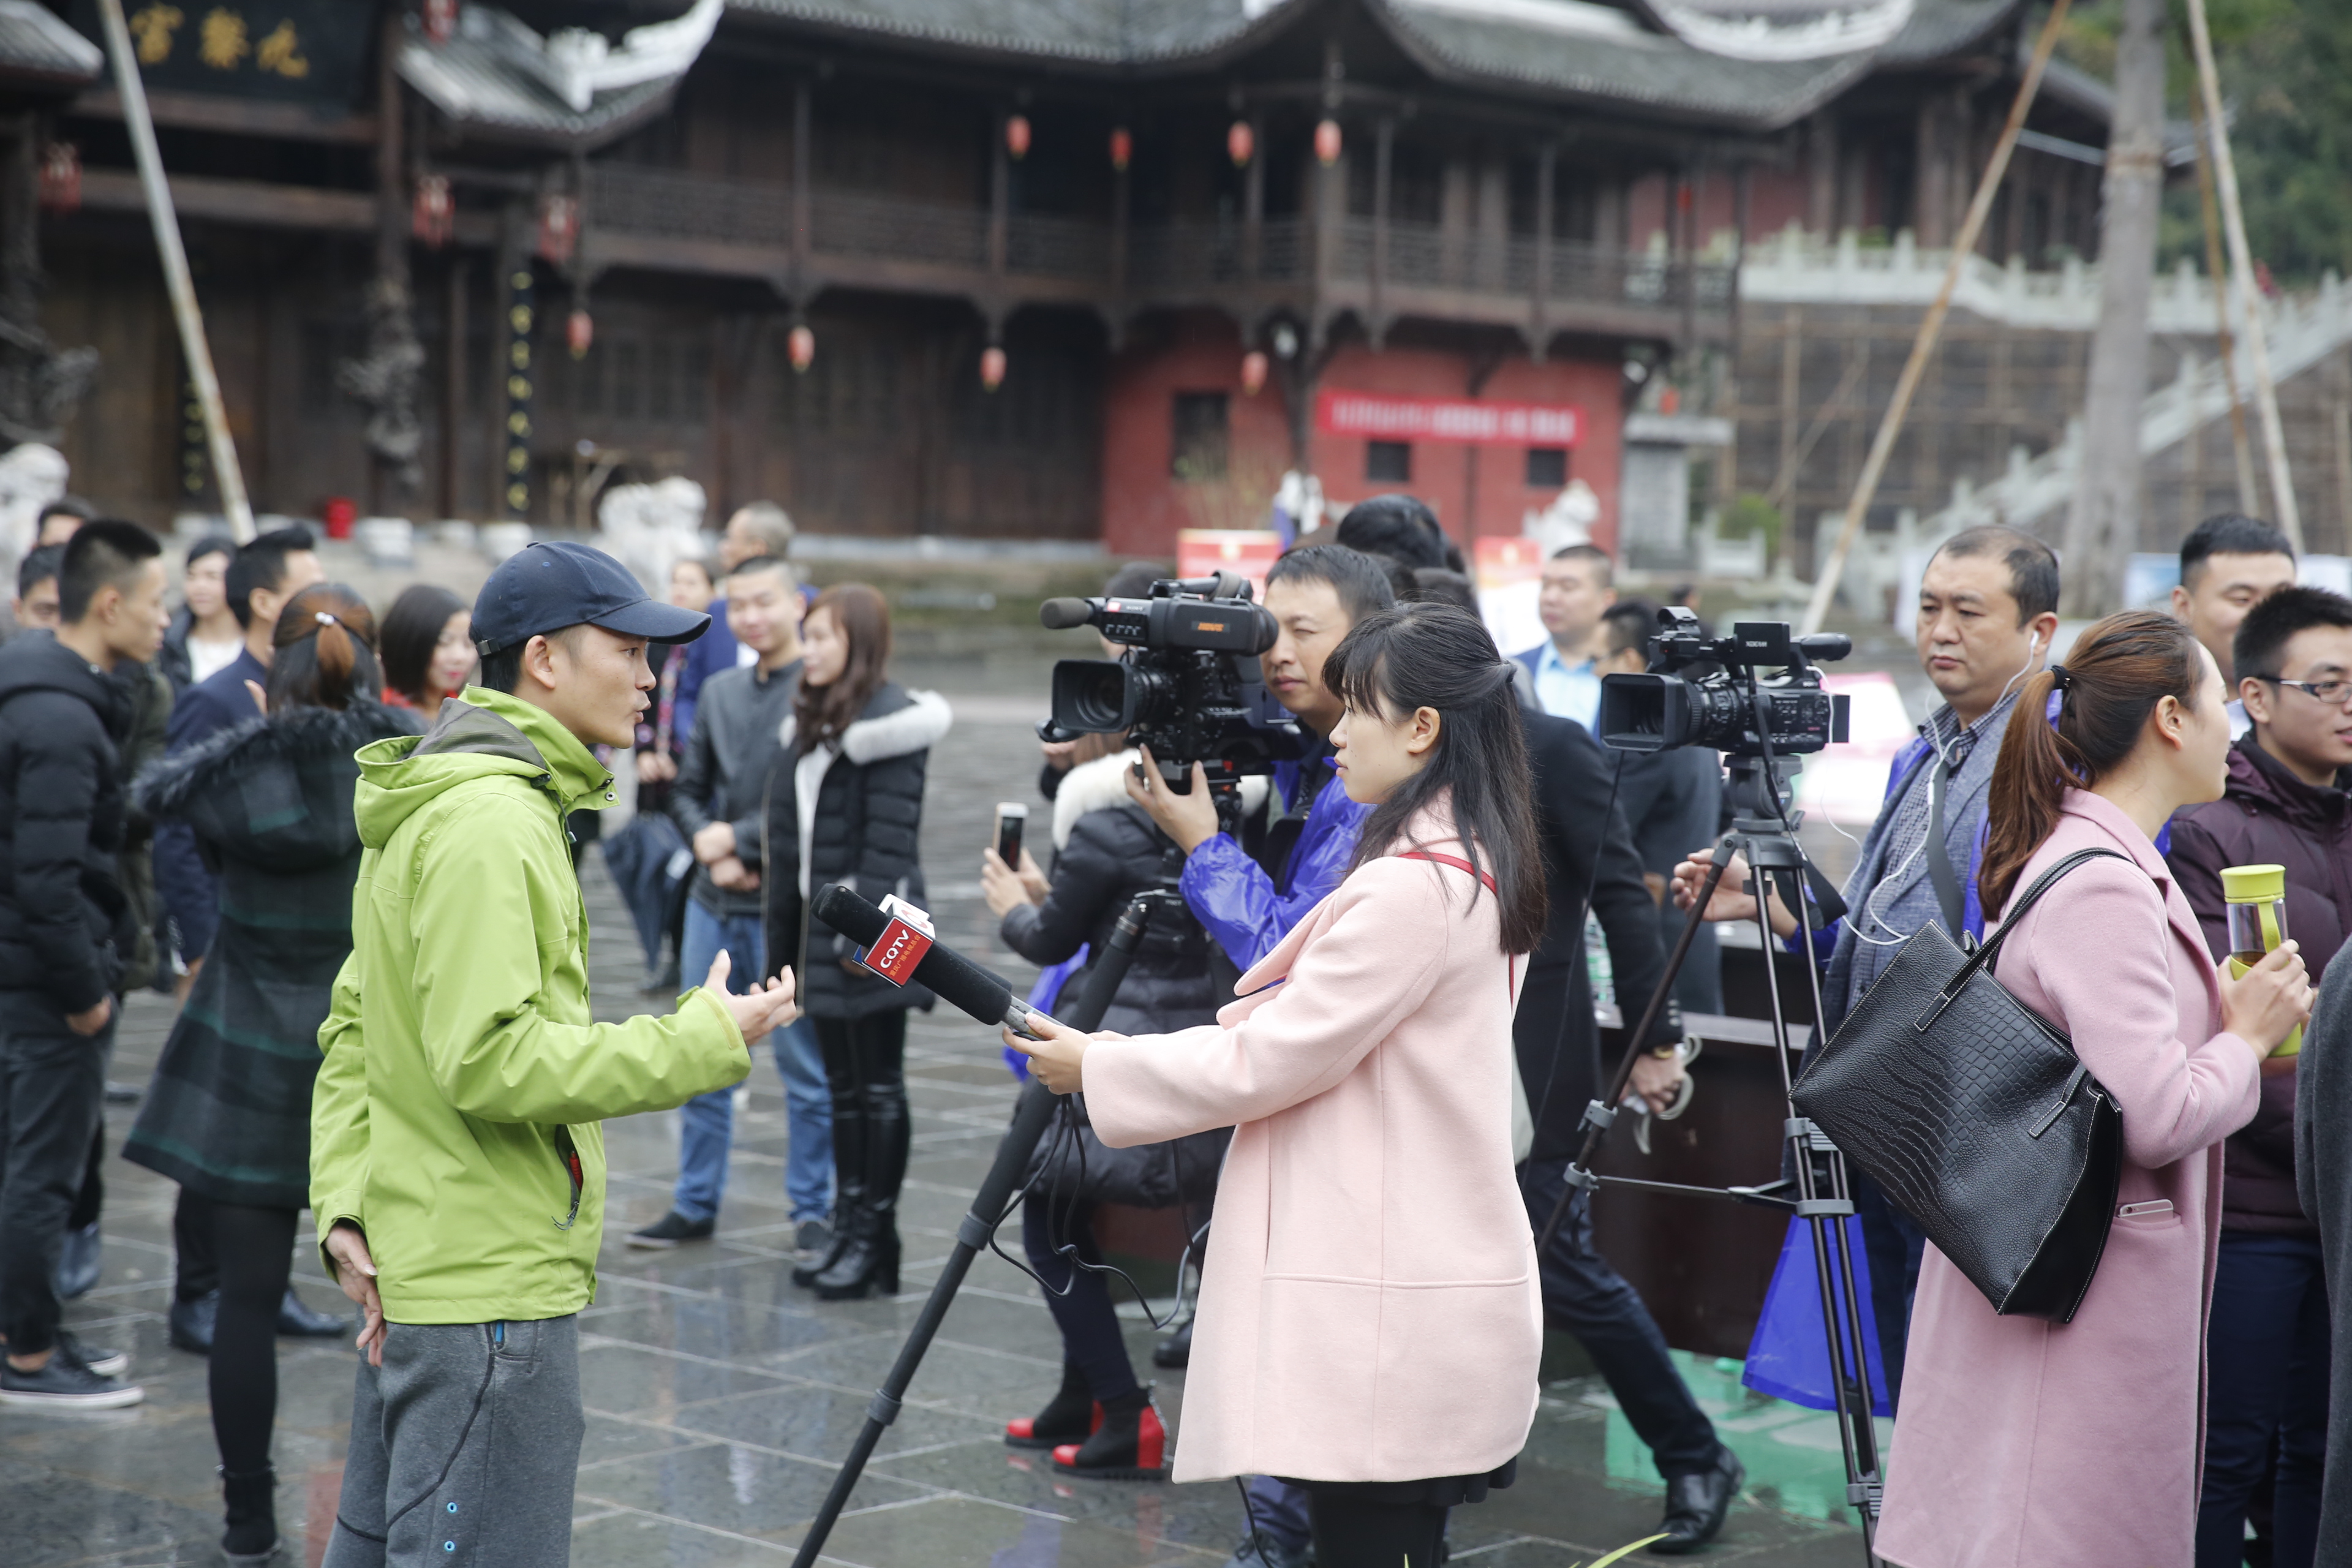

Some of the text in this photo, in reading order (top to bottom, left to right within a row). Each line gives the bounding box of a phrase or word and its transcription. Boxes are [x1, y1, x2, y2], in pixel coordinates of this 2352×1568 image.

[880, 929, 910, 968] CQTV
[889, 935, 921, 977] 重庆广播电视总台
